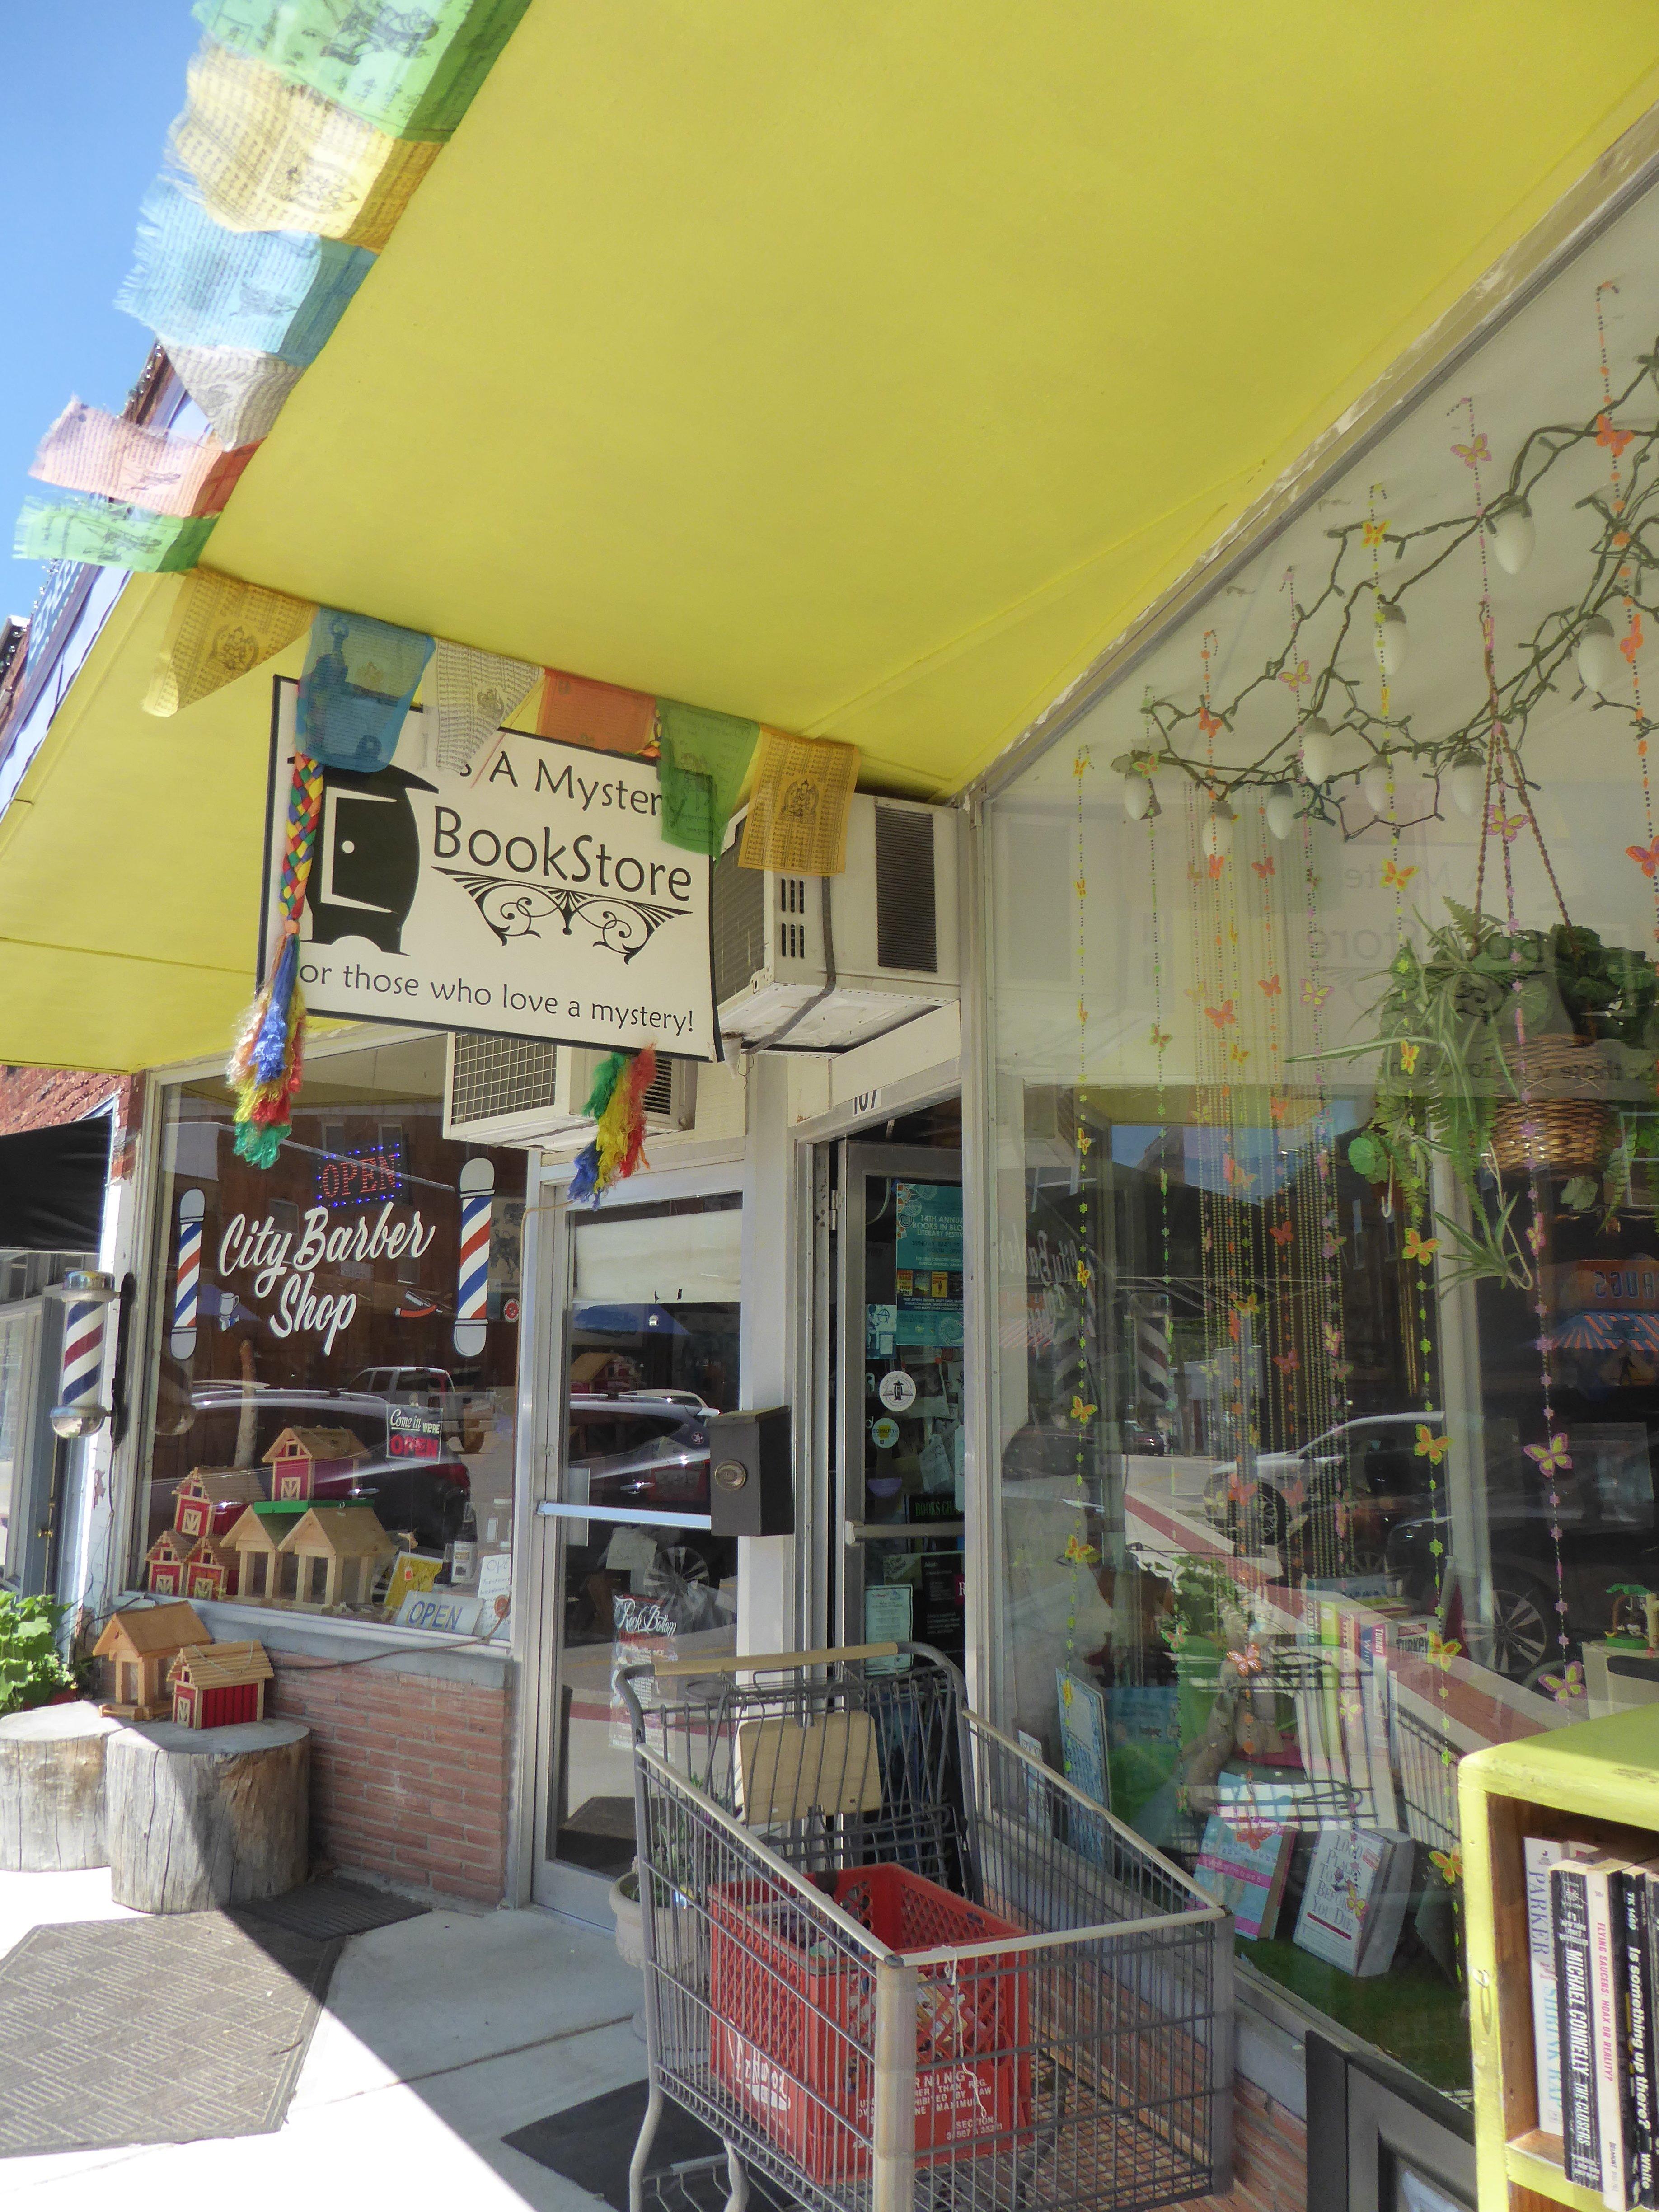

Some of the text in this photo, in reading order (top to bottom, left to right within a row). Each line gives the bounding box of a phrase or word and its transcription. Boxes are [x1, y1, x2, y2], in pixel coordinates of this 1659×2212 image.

[488, 750, 663, 817] A Myster
[432, 805, 693, 902] BookStore
[299, 963, 694, 1038] or those who love a mystery!
[323, 1153, 399, 1199] OPEN
[912, 1222, 938, 1230] BOOKS
[218, 1201, 436, 1298] City Barber
[270, 1272, 358, 1356] Shop
[389, 1408, 440, 1434] Come in WE'RE
[389, 1434, 439, 1458] OPEN
[408, 1600, 463, 1631] OPEN
[1375, 1628, 1384, 1654] TURKEY
[1528, 1870, 1551, 1957] PARKER
[1597, 1922, 1607, 1953] FLYING
[1565, 1949, 1588, 2006] MICHAEL
[1601, 1999, 1611, 2023] HOAX
[1603, 2026, 1612, 2038] OR
[1568, 2009, 1590, 2077] CONNELLY
[1627, 1945, 1651, 2131] Is something up there?
[915, 2070, 965, 2088] RNING
[1603, 2040, 1614, 2081] REALITY?
[1575, 2082, 1588, 2099] THE
[1575, 2101, 1591, 2146] CLOSERS
